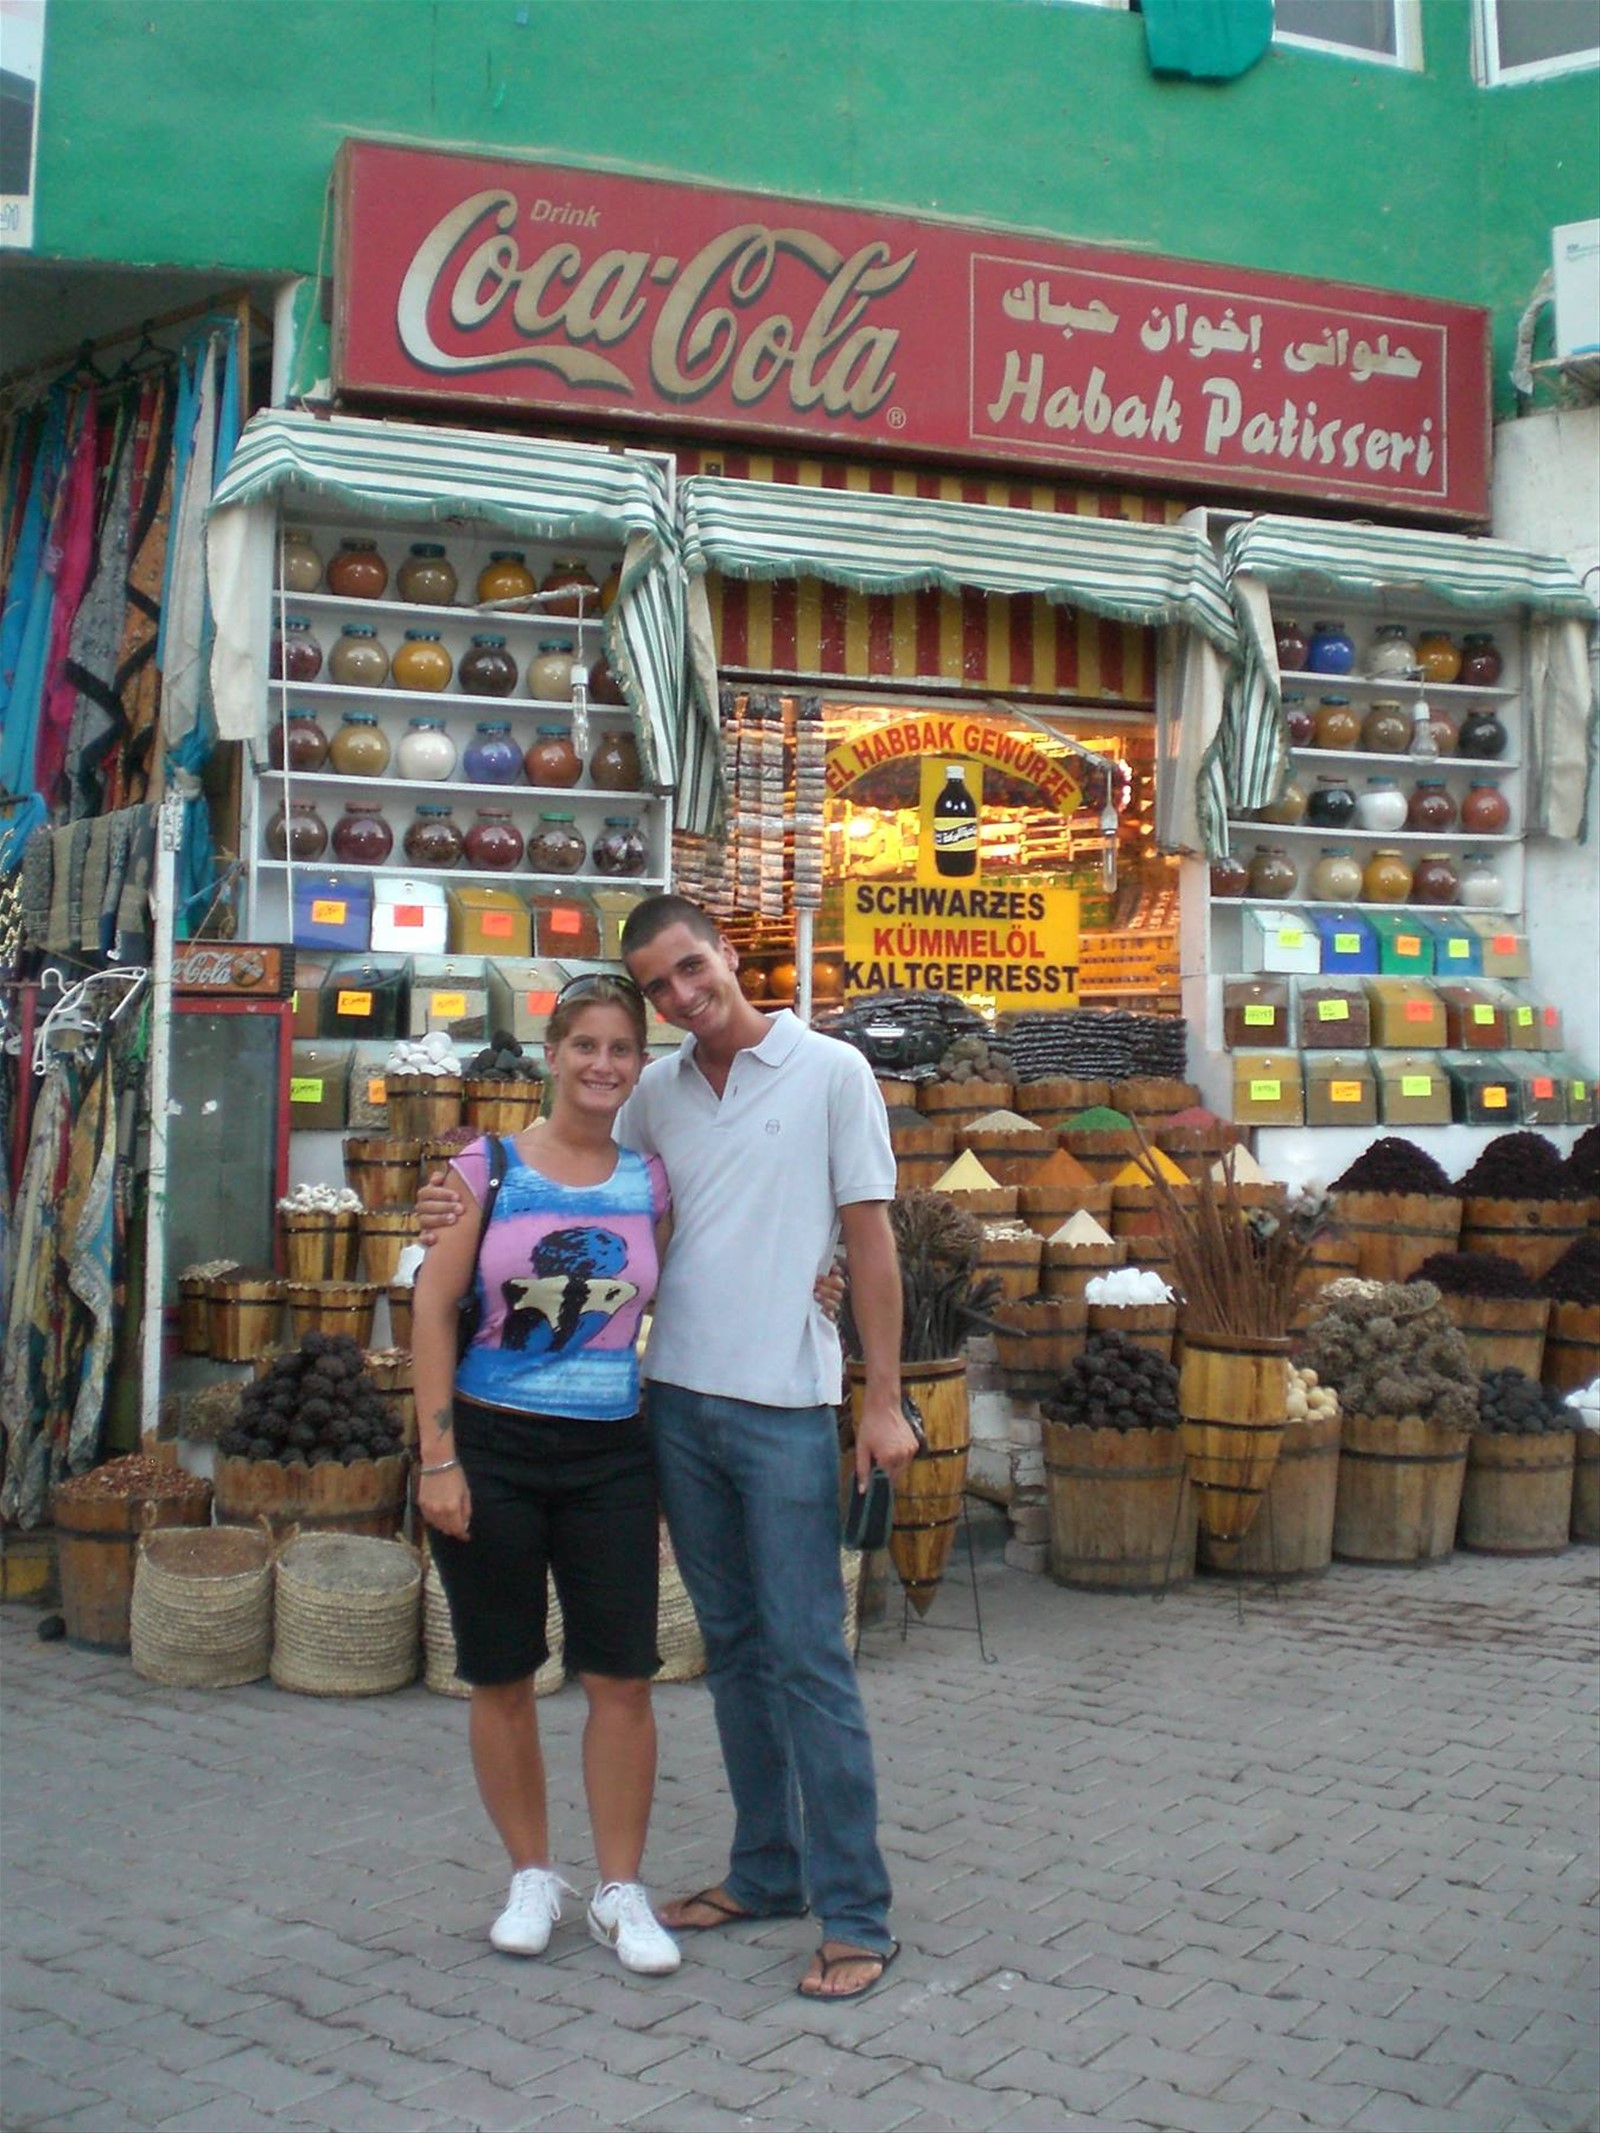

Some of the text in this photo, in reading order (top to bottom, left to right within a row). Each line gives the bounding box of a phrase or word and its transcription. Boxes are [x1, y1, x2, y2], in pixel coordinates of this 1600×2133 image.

[529, 199, 602, 228] Drink
[397, 189, 917, 414] Coca-Cola
[1001, 278, 1120, 339] حباك
[986, 349, 1434, 477] Habak Patisseri
[852, 721, 956, 770] HABBAK
[963, 724, 1076, 806] GEWÜRZE
[856, 884, 1046, 921] SCHWARZES
[873, 922, 1046, 959] KÜMMELÖL
[844, 960, 1080, 994] KALTGEPRESST
